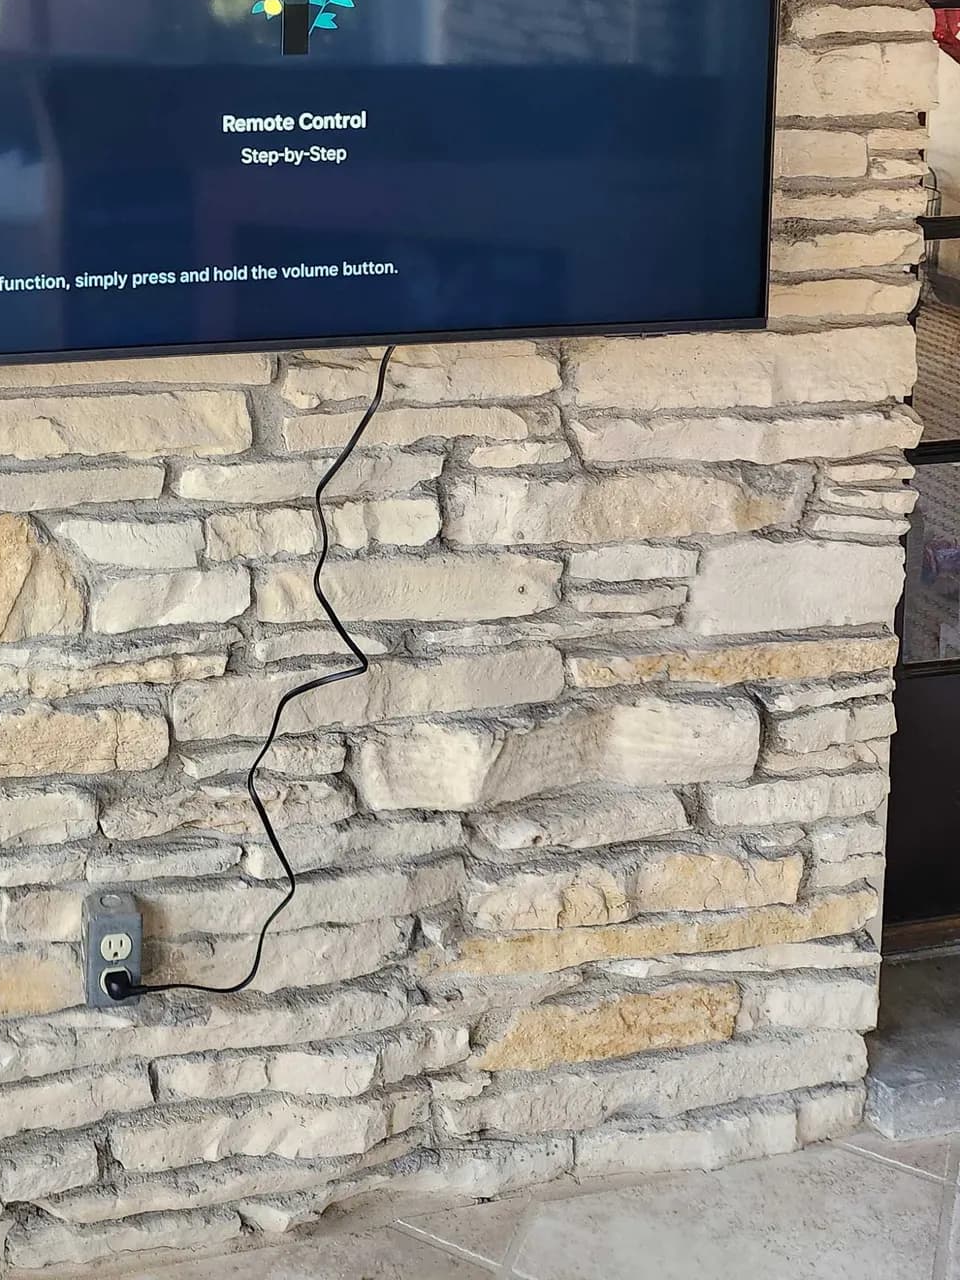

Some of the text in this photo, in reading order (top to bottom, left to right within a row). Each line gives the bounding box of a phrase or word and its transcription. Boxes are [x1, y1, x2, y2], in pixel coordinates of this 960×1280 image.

[222, 110, 367, 133] Remote Control
[241, 145, 347, 167] Step-by-Step
[75, 270, 128, 290] simply
[132, 271, 177, 289] press
[179, 266, 210, 283] and
[213, 265, 248, 282] hold
[250, 264, 278, 280] the
[281, 263, 339, 279] volume
[342, 261, 399, 276] button.
